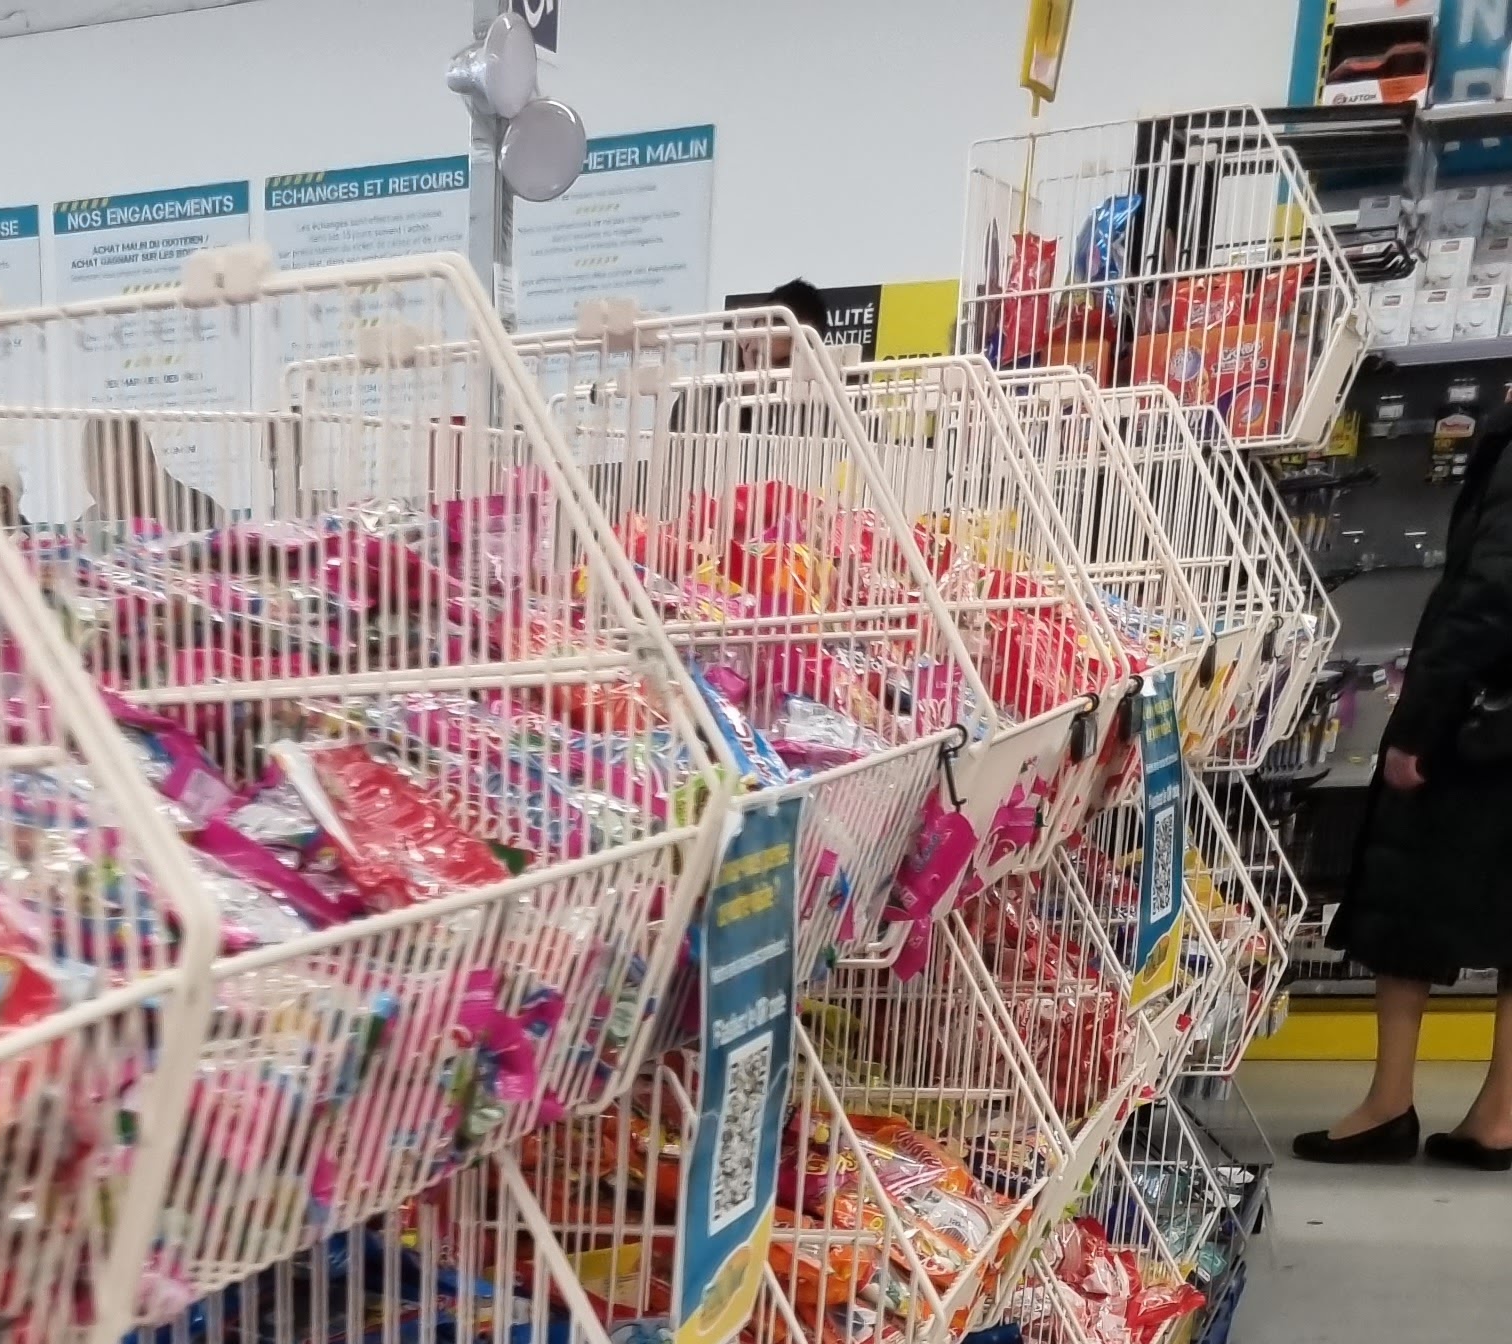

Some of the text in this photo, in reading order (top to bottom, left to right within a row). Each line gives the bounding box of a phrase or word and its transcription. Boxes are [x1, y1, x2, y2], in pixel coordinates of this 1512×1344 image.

[583, 138, 707, 170] HETER MALIN
[363, 179, 383, 197] ET
[388, 171, 464, 195] RETOURS
[67, 195, 234, 230] NOS ENGAGEMENTS
[93, 244, 119, 255] ACHAT
[71, 258, 98, 269] ACHAT
[826, 303, 875, 327] LITÉ
[823, 328, 873, 346] ANTIE
